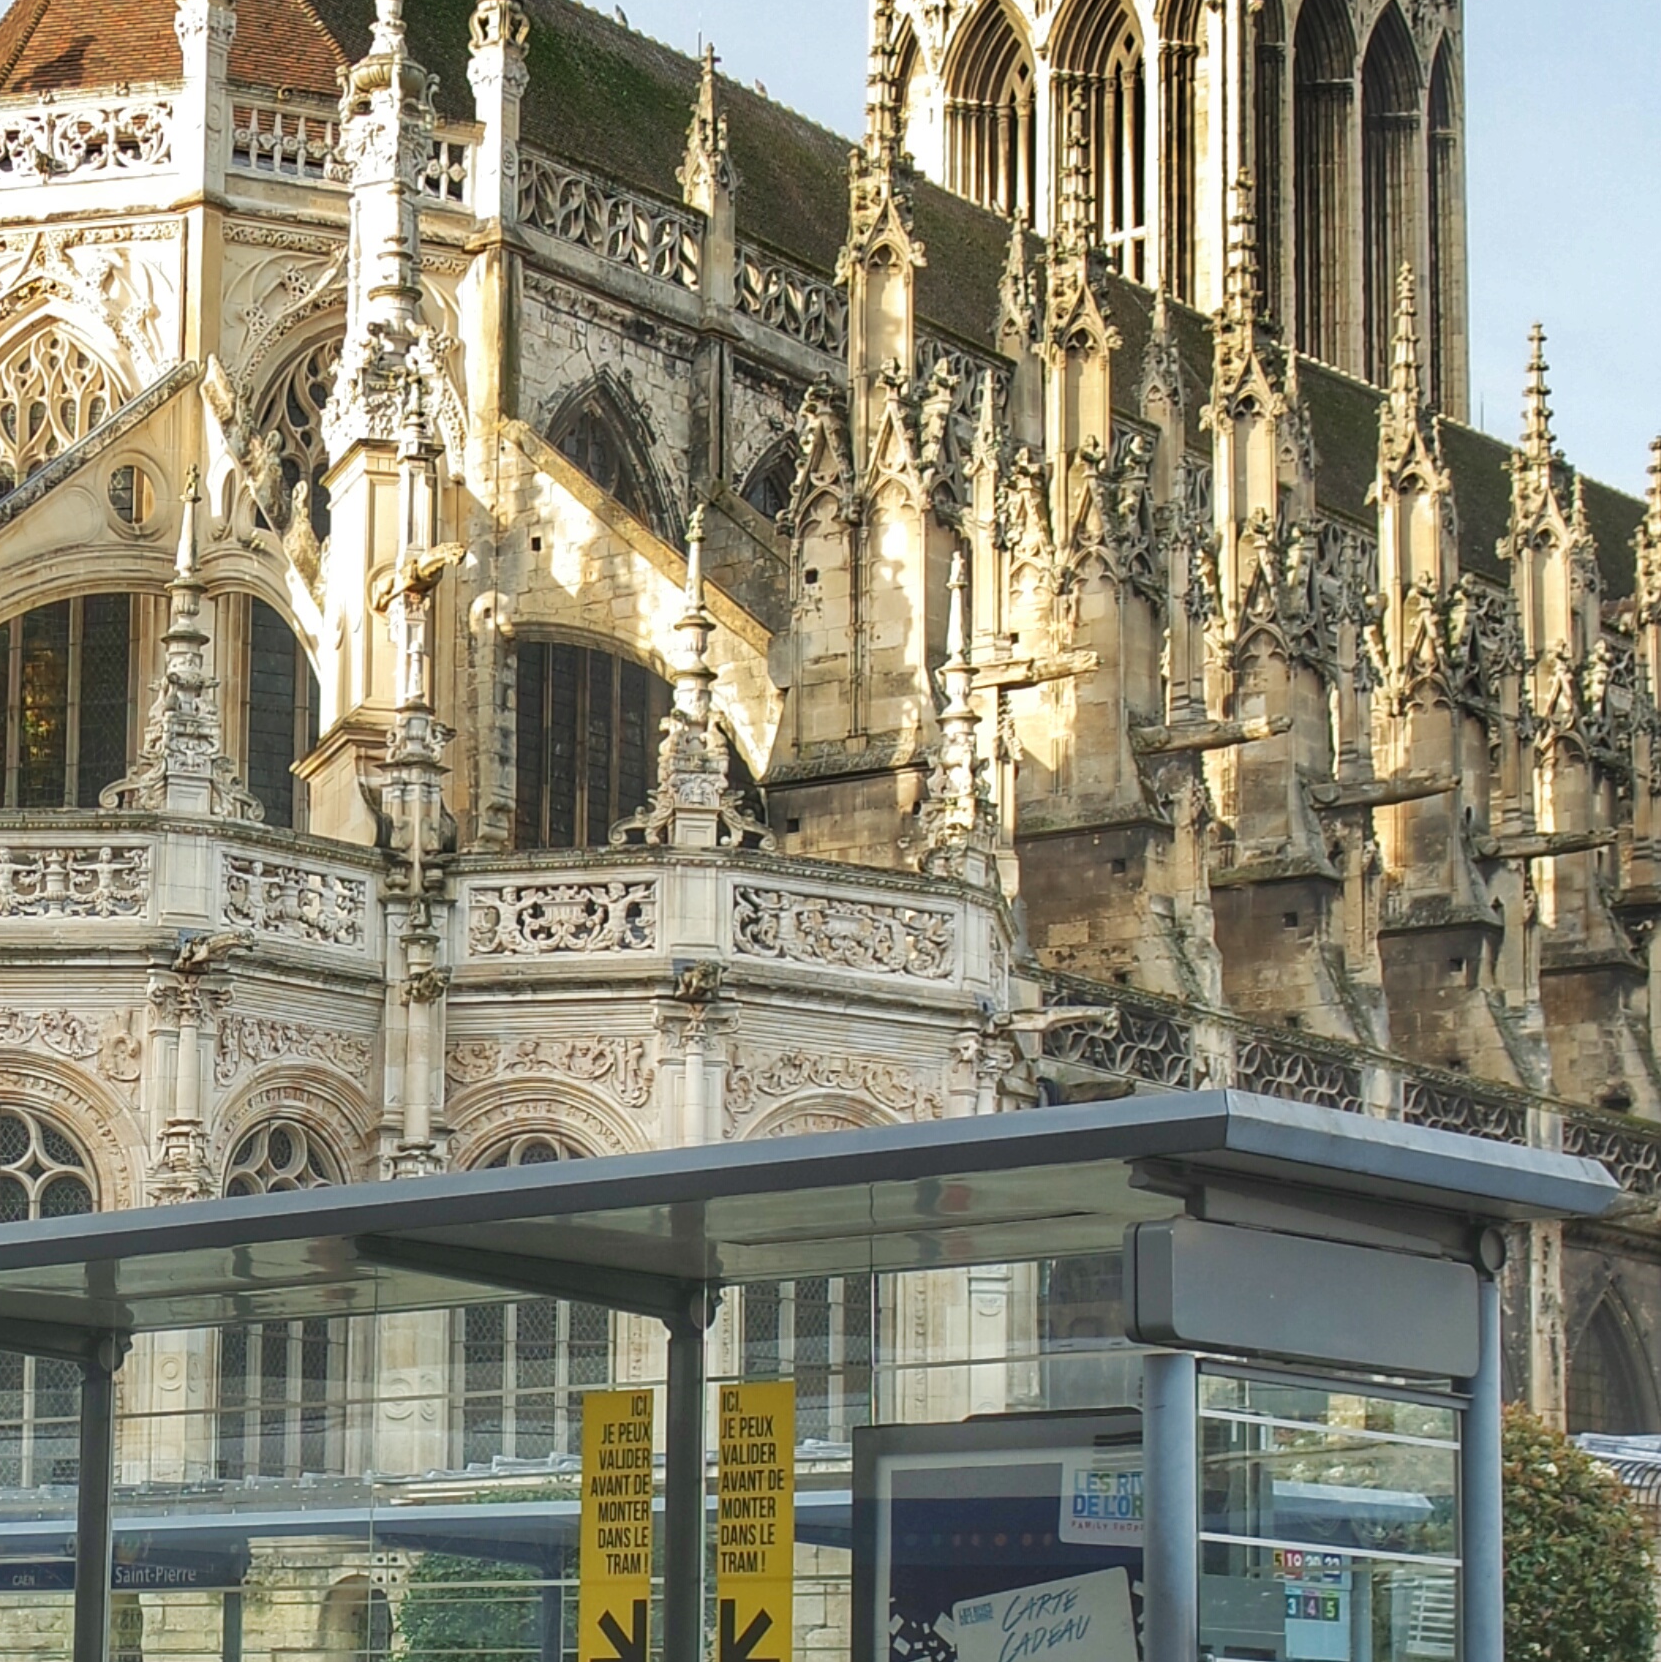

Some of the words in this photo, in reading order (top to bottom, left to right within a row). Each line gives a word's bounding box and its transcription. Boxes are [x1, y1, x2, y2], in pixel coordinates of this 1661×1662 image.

[631, 1395, 651, 1417] ICI,
[722, 1391, 742, 1413] ICI,
[601, 1424, 615, 1445] JE
[618, 1421, 651, 1443] PEUX
[722, 1418, 736, 1439] JE
[739, 1415, 773, 1437] PEUX
[599, 1447, 650, 1471] VALIDER
[722, 1443, 776, 1466] VALIDER
[591, 1476, 632, 1497] AVANT
[634, 1474, 650, 1495] DE
[722, 1471, 764, 1492] AVANT
[768, 1469, 784, 1490] DE
[1074, 1471, 1112, 1493] LES
[598, 1501, 649, 1523] MONTER
[722, 1497, 776, 1519] MONTER
[1073, 1494, 1099, 1515] DE
[598, 1528, 632, 1549] DANS
[634, 1527, 649, 1547] LE
[722, 1525, 757, 1545] DANS
[760, 1524, 775, 1544] LE
[606, 1553, 642, 1575] TRAM
[722, 1552, 758, 1573] TRAM
[1286, 1553, 1302, 1567] 10
[115, 1566, 197, 1584] Saint-Pierre
[1002, 1587, 1081, 1632] CARTE
[1306, 1599, 1316, 1616] 4
[1326, 1601, 1335, 1618] 5
